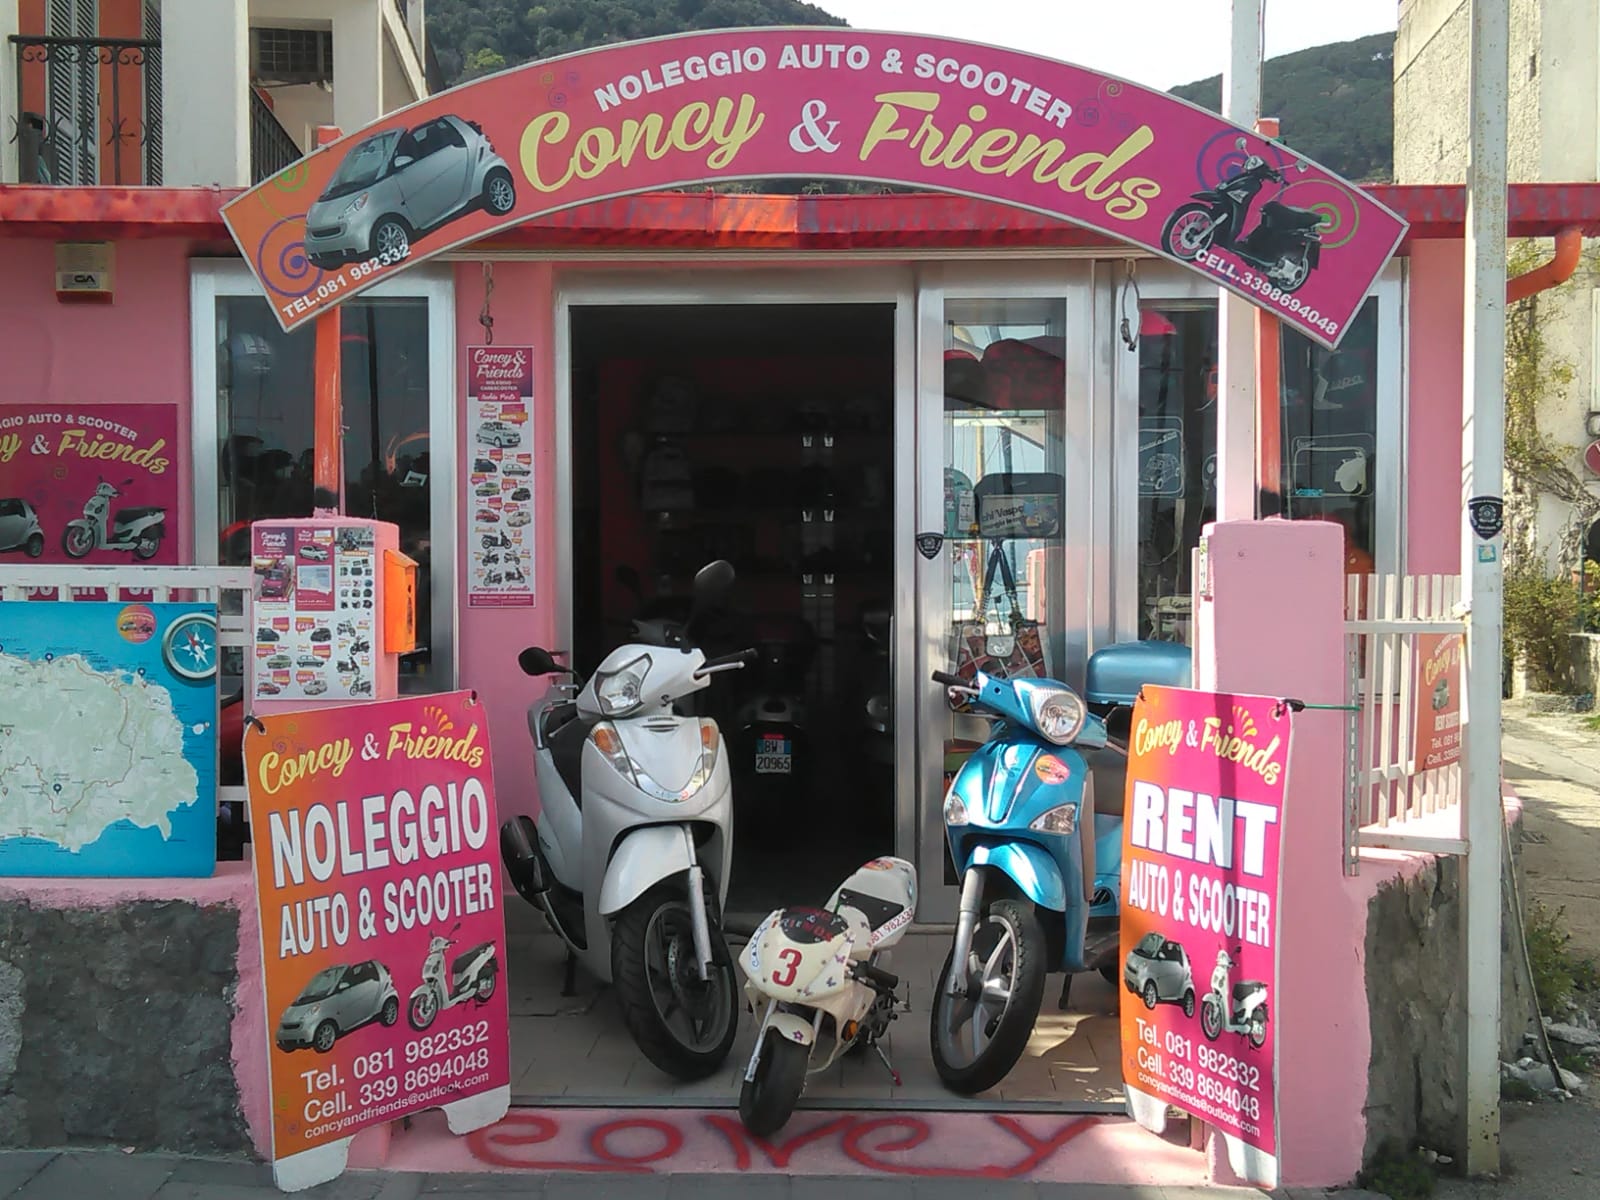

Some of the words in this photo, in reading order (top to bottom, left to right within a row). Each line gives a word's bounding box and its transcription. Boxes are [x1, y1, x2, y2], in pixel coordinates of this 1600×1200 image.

[594, 45, 766, 111] NOLEGGIO
[778, 44, 870, 70] AUTO
[881, 48, 904, 73] &
[914, 54, 1072, 129] SCOOTER
[520, 94, 764, 193] Concy
[789, 100, 840, 153] &
[859, 91, 1161, 220] Friends
[282, 275, 347, 319] TEL.081
[350, 244, 411, 281] 982332
[476, 362, 523, 379] Friends
[0, 415, 23, 429] GIO
[28, 413, 62, 424] AUTO
[65, 414, 74, 424] &
[78, 415, 138, 441] SCOOTER
[30, 434, 50, 454] &
[57, 429, 169, 474] Friends
[259, 738, 353, 794] Concy
[361, 733, 380, 760] &
[386, 722, 484, 768] Friends
[1135, 717, 1183, 757] Concy
[1185, 720, 1199, 748] &
[1201, 716, 1281, 786] Friends
[269, 777, 488, 888] NOLEGGIO
[1131, 780, 1278, 878] RENT
[280, 892, 349, 959] AUTO
[358, 887, 377, 941] &
[383, 863, 494, 934] SCOOTER
[1128, 859, 1169, 917] AUTO
[1172, 869, 1185, 922] &
[1188, 873, 1269, 947] SCOOTER
[772, 948, 803, 987] 3
[301, 1064, 345, 1094] Tel.
[353, 1049, 394, 1079] 081
[404, 1021, 489, 1063] 982332
[303, 1092, 353, 1123] Cell.
[359, 1075, 398, 1106] 339
[404, 1048, 489, 1092] 8694048
[1136, 1017, 1161, 1049] Tel.
[1165, 1031, 1192, 1061] 081
[1198, 1044, 1260, 1092] 982332
[1137, 1046, 1167, 1078] Cell.
[1169, 1060, 1194, 1090] 339
[1197, 1072, 1260, 1121] 8694048
[304, 1073, 489, 1139] concyandfriends@outlook.com
[1138, 1071, 1260, 1137] concyandfriends@outlook.com
